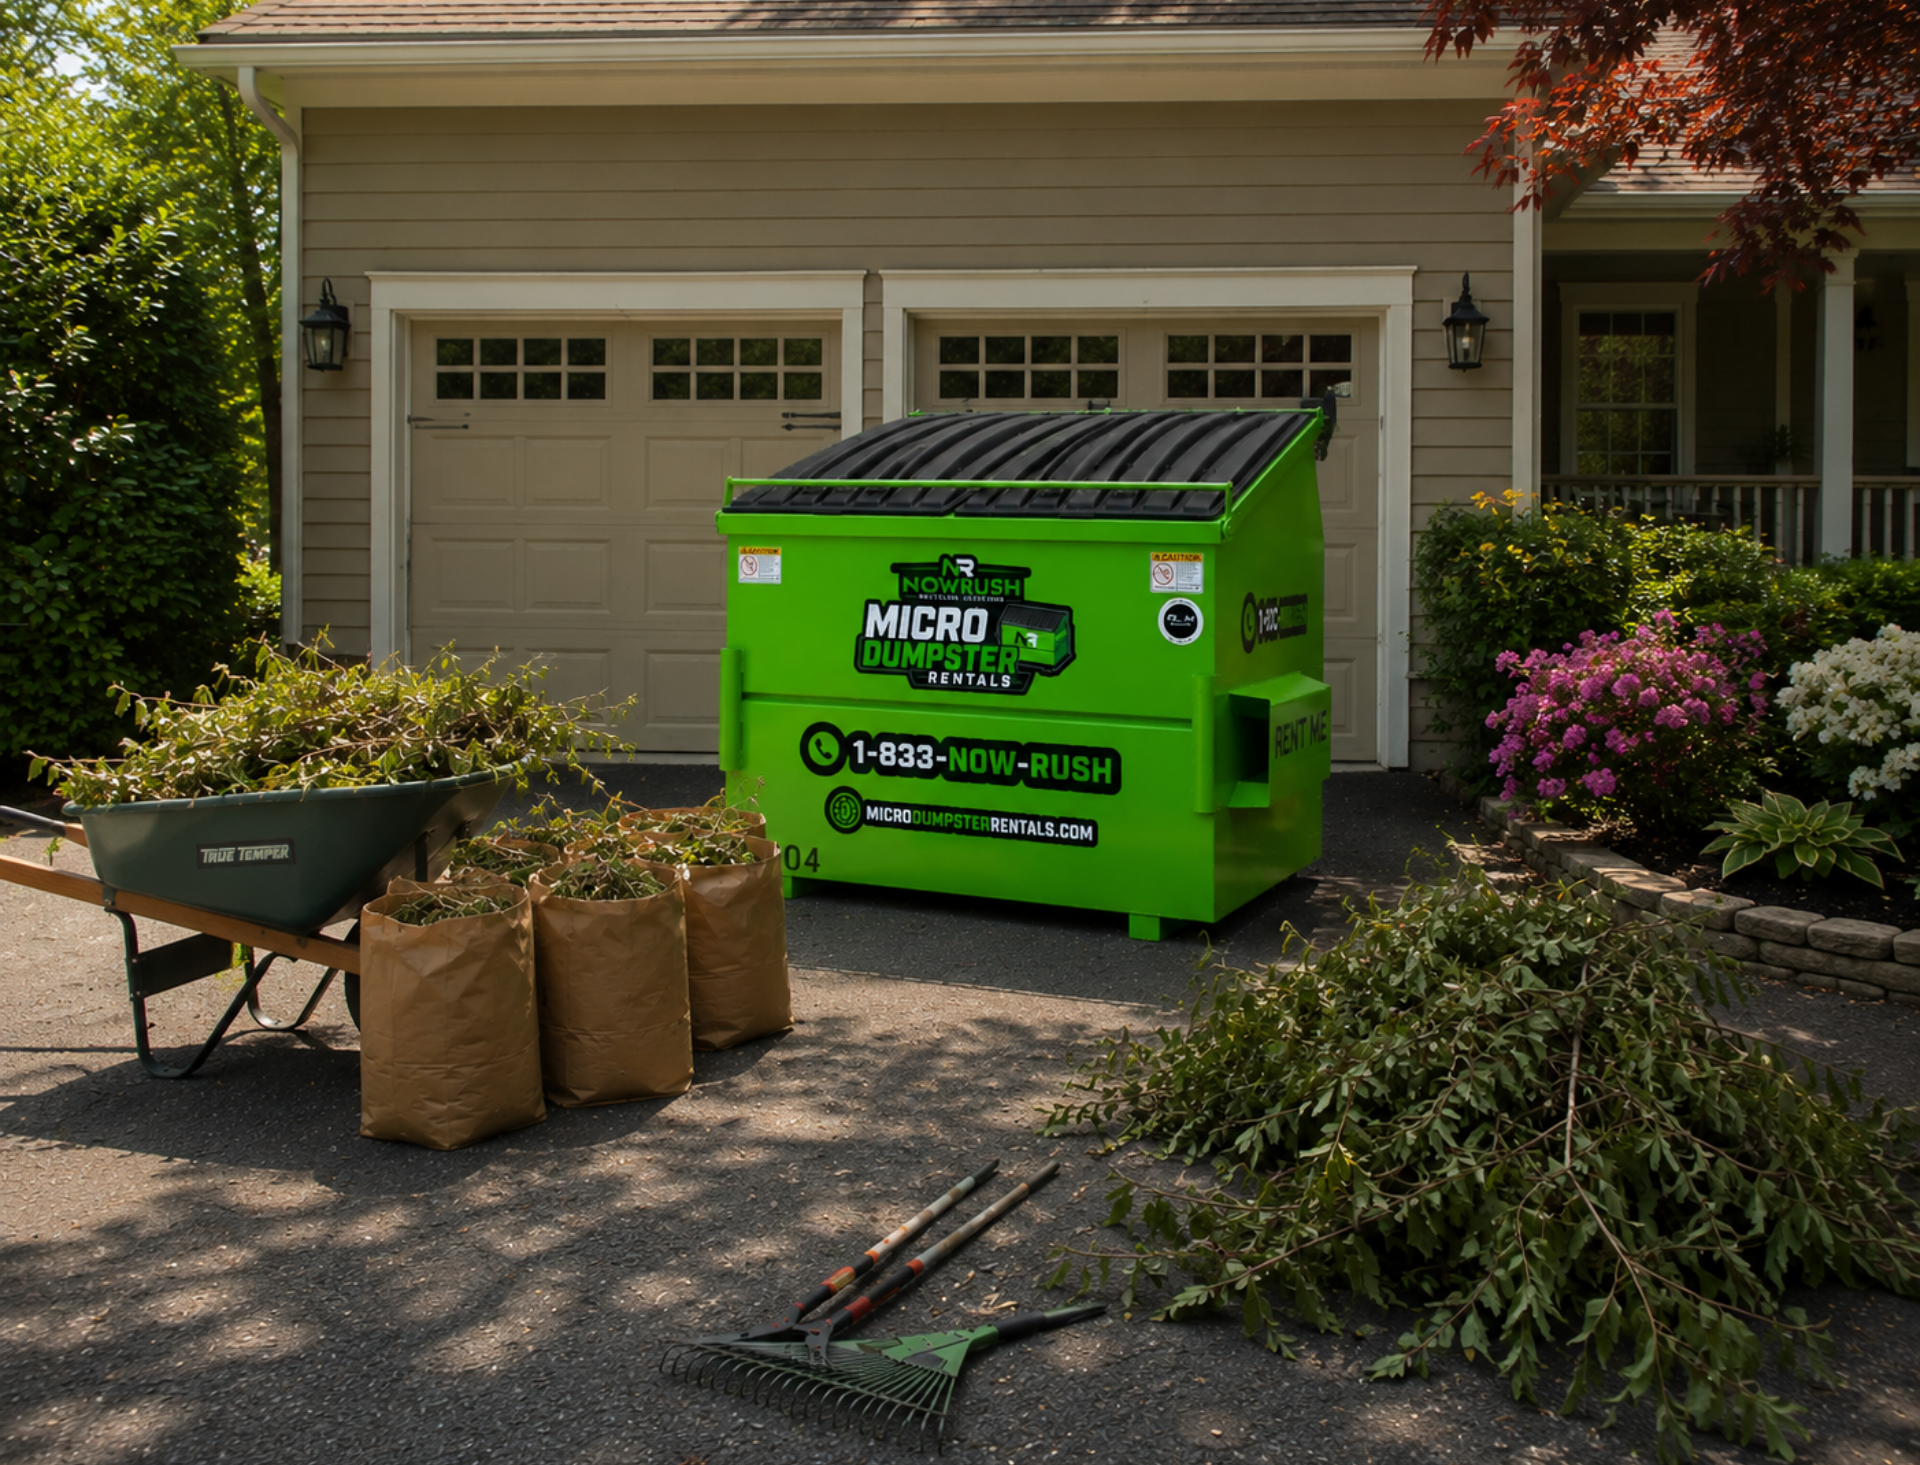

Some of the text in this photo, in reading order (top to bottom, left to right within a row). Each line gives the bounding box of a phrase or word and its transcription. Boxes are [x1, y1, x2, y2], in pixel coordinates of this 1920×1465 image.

[942, 558, 975, 577] NR
[903, 576, 1020, 596] NOWRUSH
[865, 604, 989, 643] MICRO
[862, 640, 1020, 674] DUMPSTER
[928, 671, 1011, 688] RENTALS
[1275, 710, 1327, 759] RENT ME
[852, 740, 1113, 784] 1-833-NOW-RUSH
[866, 805, 1093, 841] MICRODUMPSTERRENTALS.COM
[201, 844, 289, 863] TRUE TEMPER
[784, 844, 821, 873] 04
